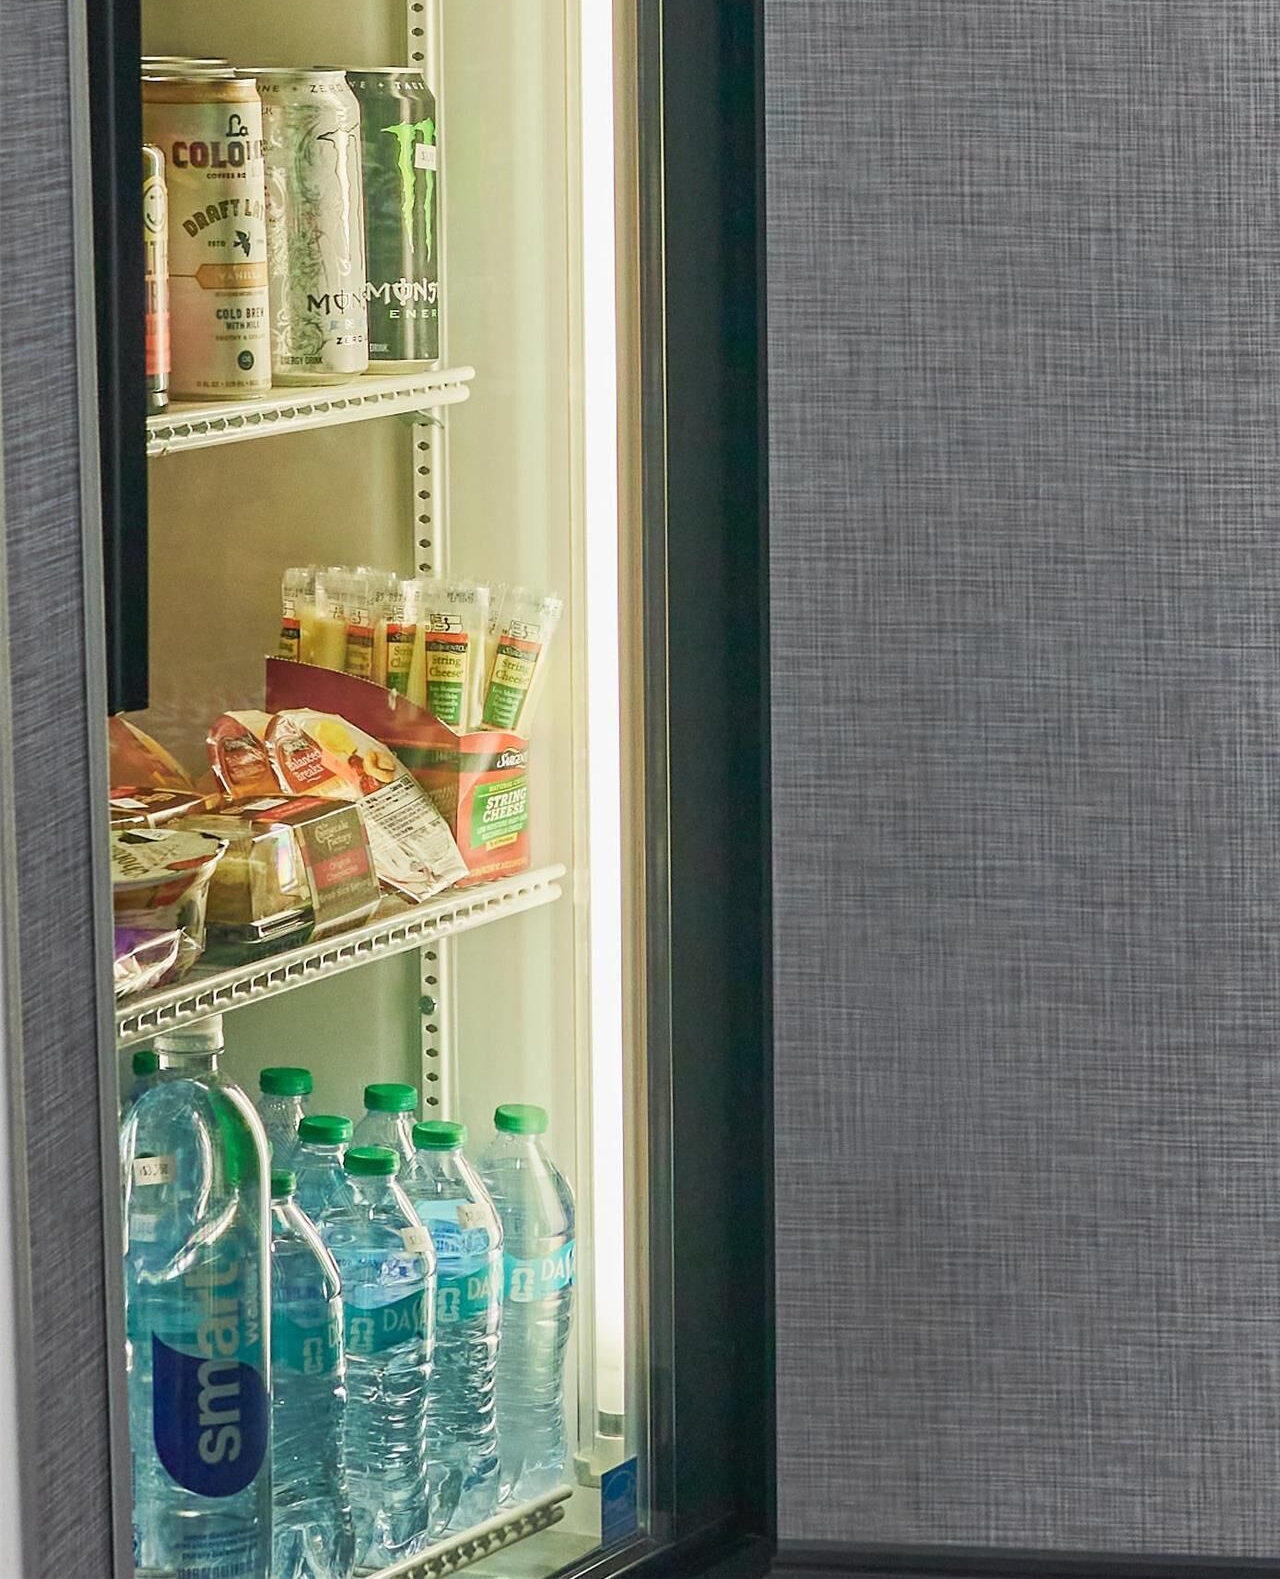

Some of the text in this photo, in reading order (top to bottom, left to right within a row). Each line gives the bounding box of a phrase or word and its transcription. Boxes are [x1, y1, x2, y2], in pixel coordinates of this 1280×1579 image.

[226, 114, 249, 137] La
[182, 199, 240, 237] DRAFT
[366, 278, 438, 307] MONS
[216, 309, 242, 320] COLD
[389, 309, 438, 319] ENER
[432, 655, 462, 667] String
[429, 667, 462, 678] Cheese
[497, 750, 528, 768] SARGEN
[295, 764, 324, 782] Breaks
[486, 787, 527, 810] STRING
[483, 801, 525, 823] CHEESE
[541, 1246, 573, 1282] DAS
[185, 1262, 241, 1464] smart
